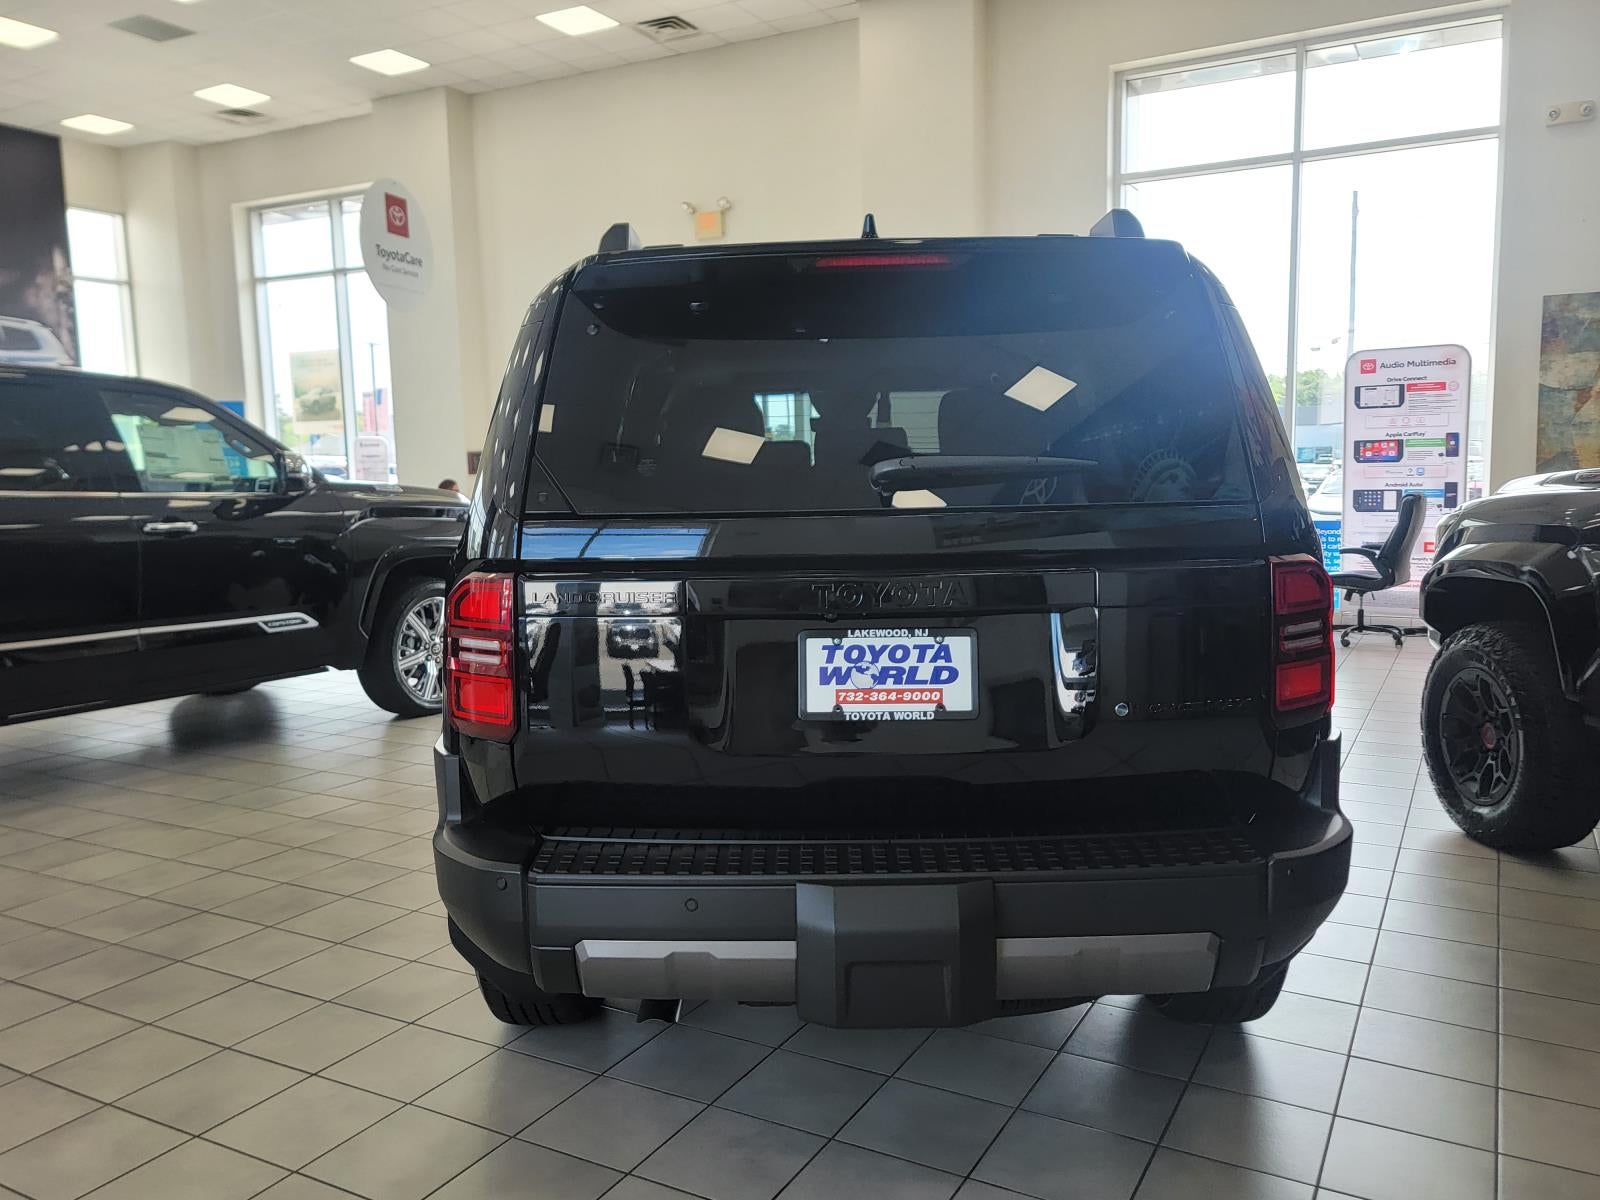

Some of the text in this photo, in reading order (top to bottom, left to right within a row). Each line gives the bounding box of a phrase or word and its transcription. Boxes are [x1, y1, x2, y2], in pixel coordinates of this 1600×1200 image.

[375, 244, 423, 266] ToyotaCare
[1380, 358, 1457, 369] Audio Multimedia
[532, 591, 677, 604] LAND CRUISER
[811, 581, 970, 608] TOYOTA
[847, 629, 929, 638] LAKEWOOD, NJ
[821, 644, 953, 664] TOYOTA
[819, 662, 959, 688] WORLD
[838, 691, 941, 701] 732-364-9000
[844, 711, 935, 721] TOYOTA WORLD
